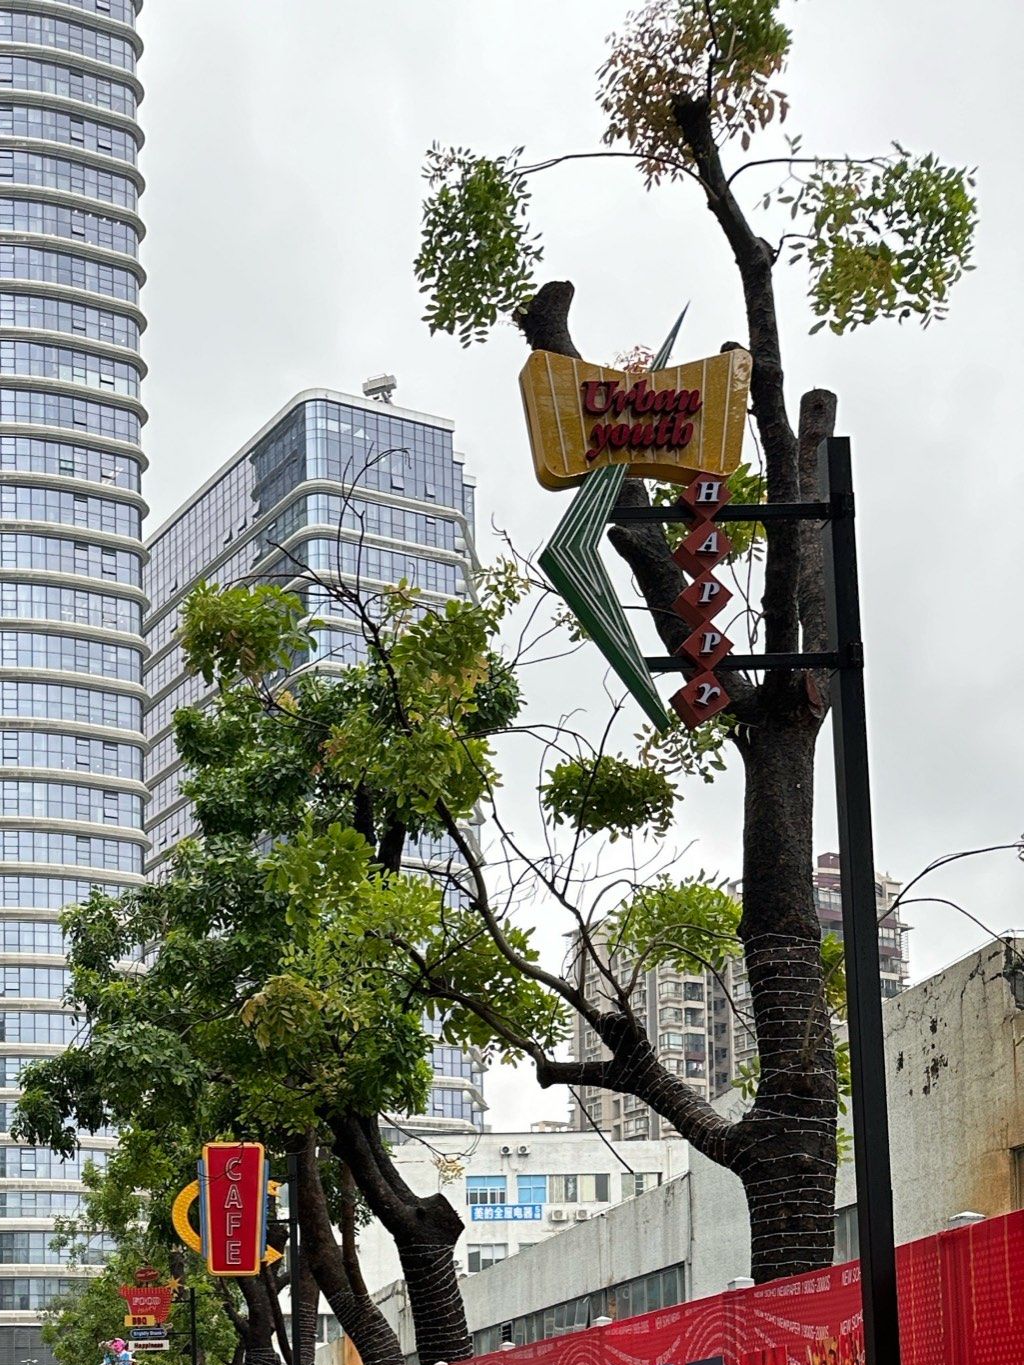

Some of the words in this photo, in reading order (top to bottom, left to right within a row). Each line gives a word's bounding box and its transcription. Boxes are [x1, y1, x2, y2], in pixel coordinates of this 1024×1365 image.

[581, 379, 703, 417] Urban
[695, 481, 723, 707] HAPPY
[224, 1157, 243, 1265] CAFE
[134, 1340, 164, 1351] Happiness
